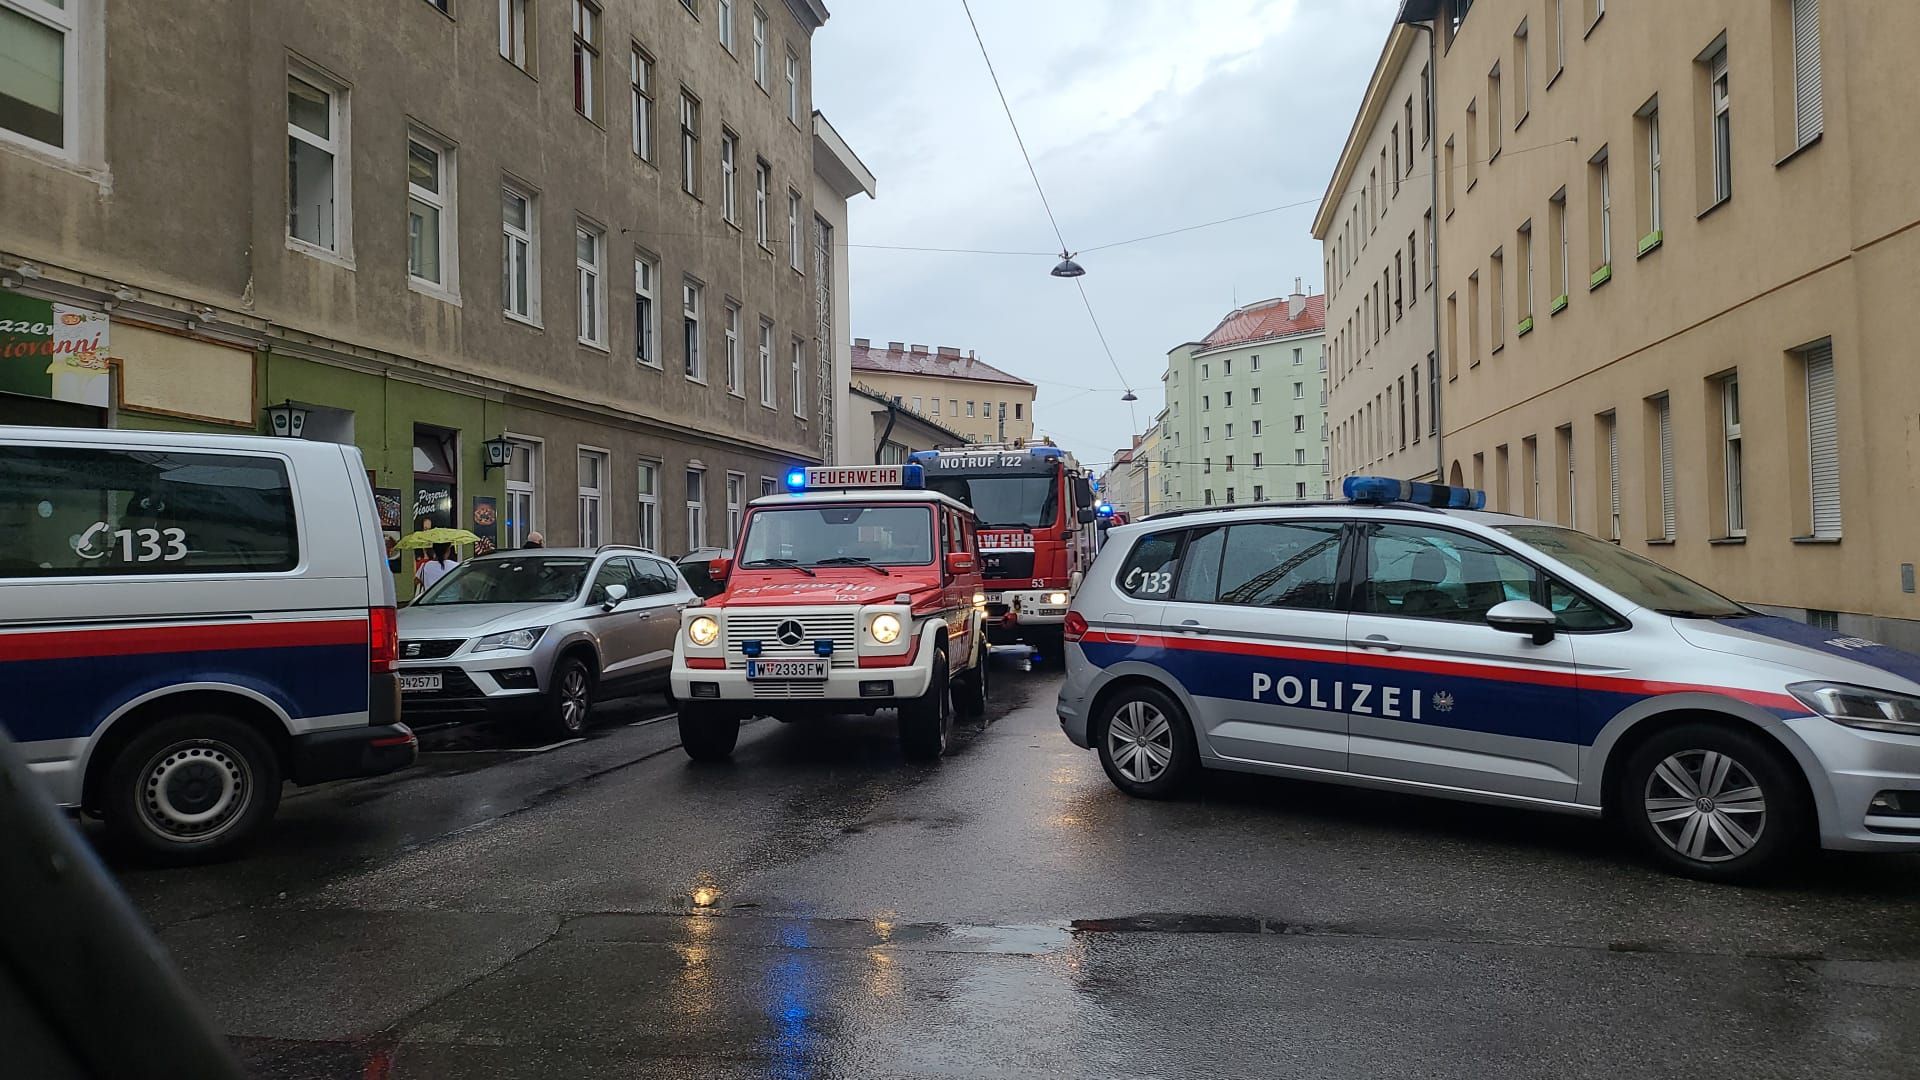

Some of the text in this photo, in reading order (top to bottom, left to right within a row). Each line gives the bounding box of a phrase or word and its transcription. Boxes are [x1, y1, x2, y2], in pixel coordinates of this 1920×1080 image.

[0, 332, 101, 357] iovanni
[940, 456, 1022, 469] NOTRUF 122
[810, 469, 897, 484] FEUERWEHR
[418, 489, 449, 504] Pizzeria
[114, 527, 188, 562] 133
[1031, 579, 1044, 588] 53
[1141, 571, 1172, 594] 133
[757, 662, 825, 676] W 2333FW
[1252, 672, 1421, 720] POLIZEI
